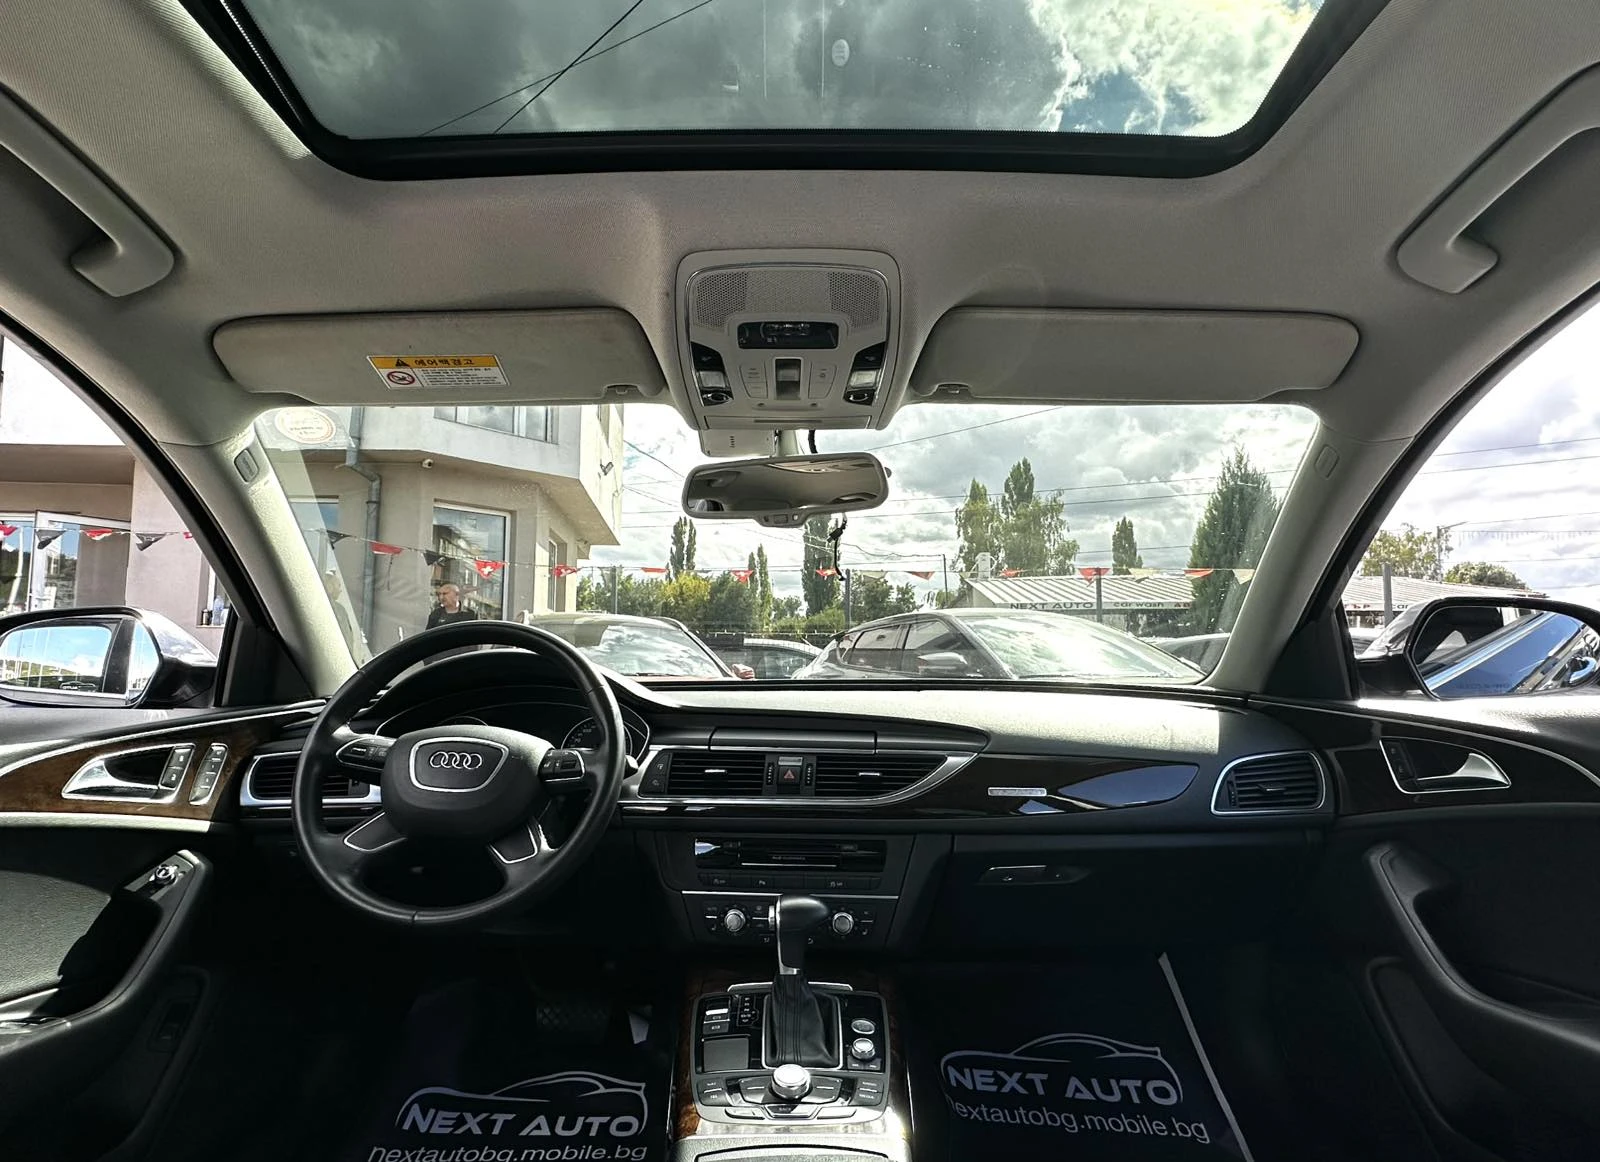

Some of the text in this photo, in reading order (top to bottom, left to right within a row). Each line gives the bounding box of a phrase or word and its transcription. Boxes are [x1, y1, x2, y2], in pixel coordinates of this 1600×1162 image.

[1010, 602, 1048, 610] NEXT
[947, 1065, 1178, 1106] NEXT AUTO
[402, 1103, 640, 1137] NEXT AUTO
